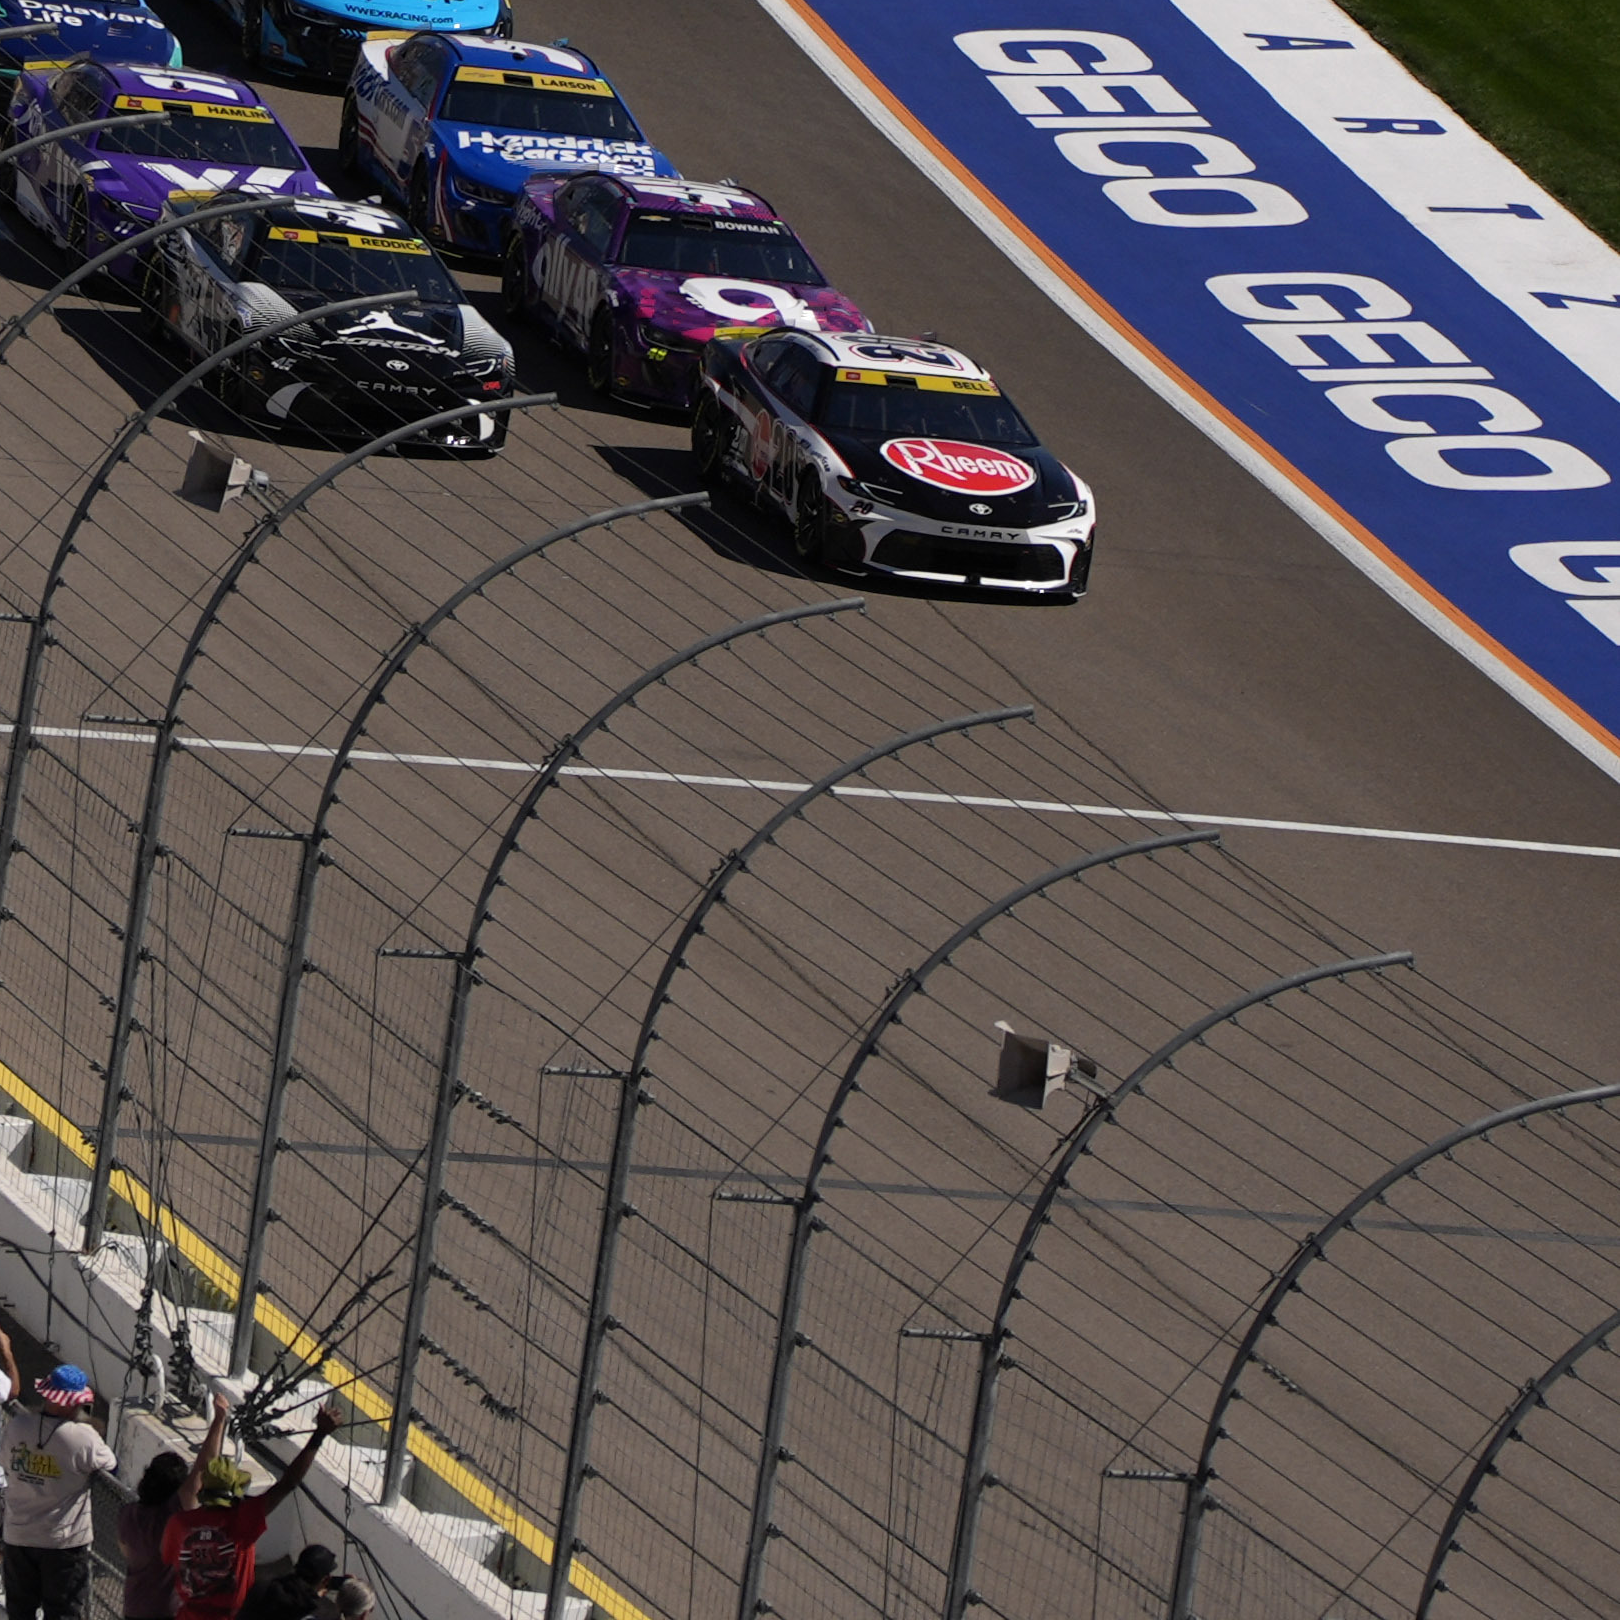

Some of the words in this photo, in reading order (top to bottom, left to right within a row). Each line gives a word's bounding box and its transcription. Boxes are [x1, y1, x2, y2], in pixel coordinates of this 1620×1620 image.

[23, 8, 83, 28] Life
[344, 3, 454, 25] WWEXRACING.com
[540, 77, 597, 92] LARSON
[207, 104, 269, 122] HAMLIN
[954, 29, 1309, 229] GEICO
[458, 130, 653, 156] Hendrick
[714, 219, 780, 236] BOWMAN
[360, 236, 426, 253] REDDICK
[321, 337, 460, 359] JORDAN
[356, 380, 439, 398] CAMRY
[952, 380, 991, 392] BELL
[1205, 272, 1612, 491] GEICO
[894, 440, 1027, 484] Rheem
[850, 499, 875, 515] 20
[940, 525, 1021, 541] CAMRY
